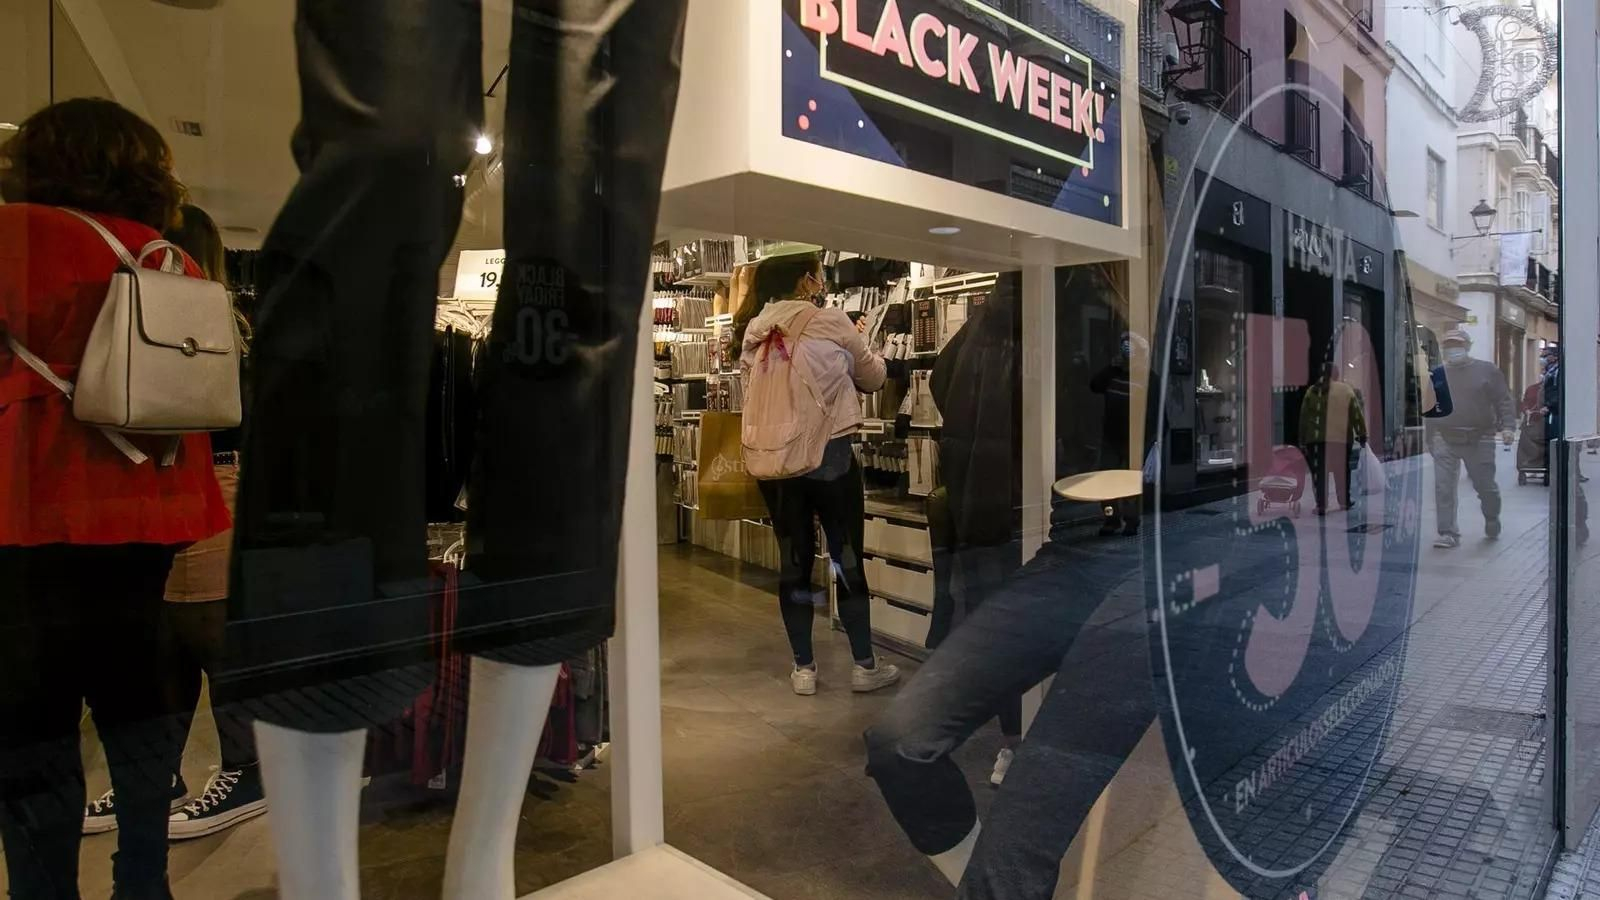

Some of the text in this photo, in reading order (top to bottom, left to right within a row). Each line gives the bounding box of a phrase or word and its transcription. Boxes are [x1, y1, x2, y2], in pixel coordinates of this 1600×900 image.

[801, 0, 1105, 144] BLACK WEEK!
[1288, 209, 1359, 284] HASTA
[1235, 770, 1256, 814] EN
